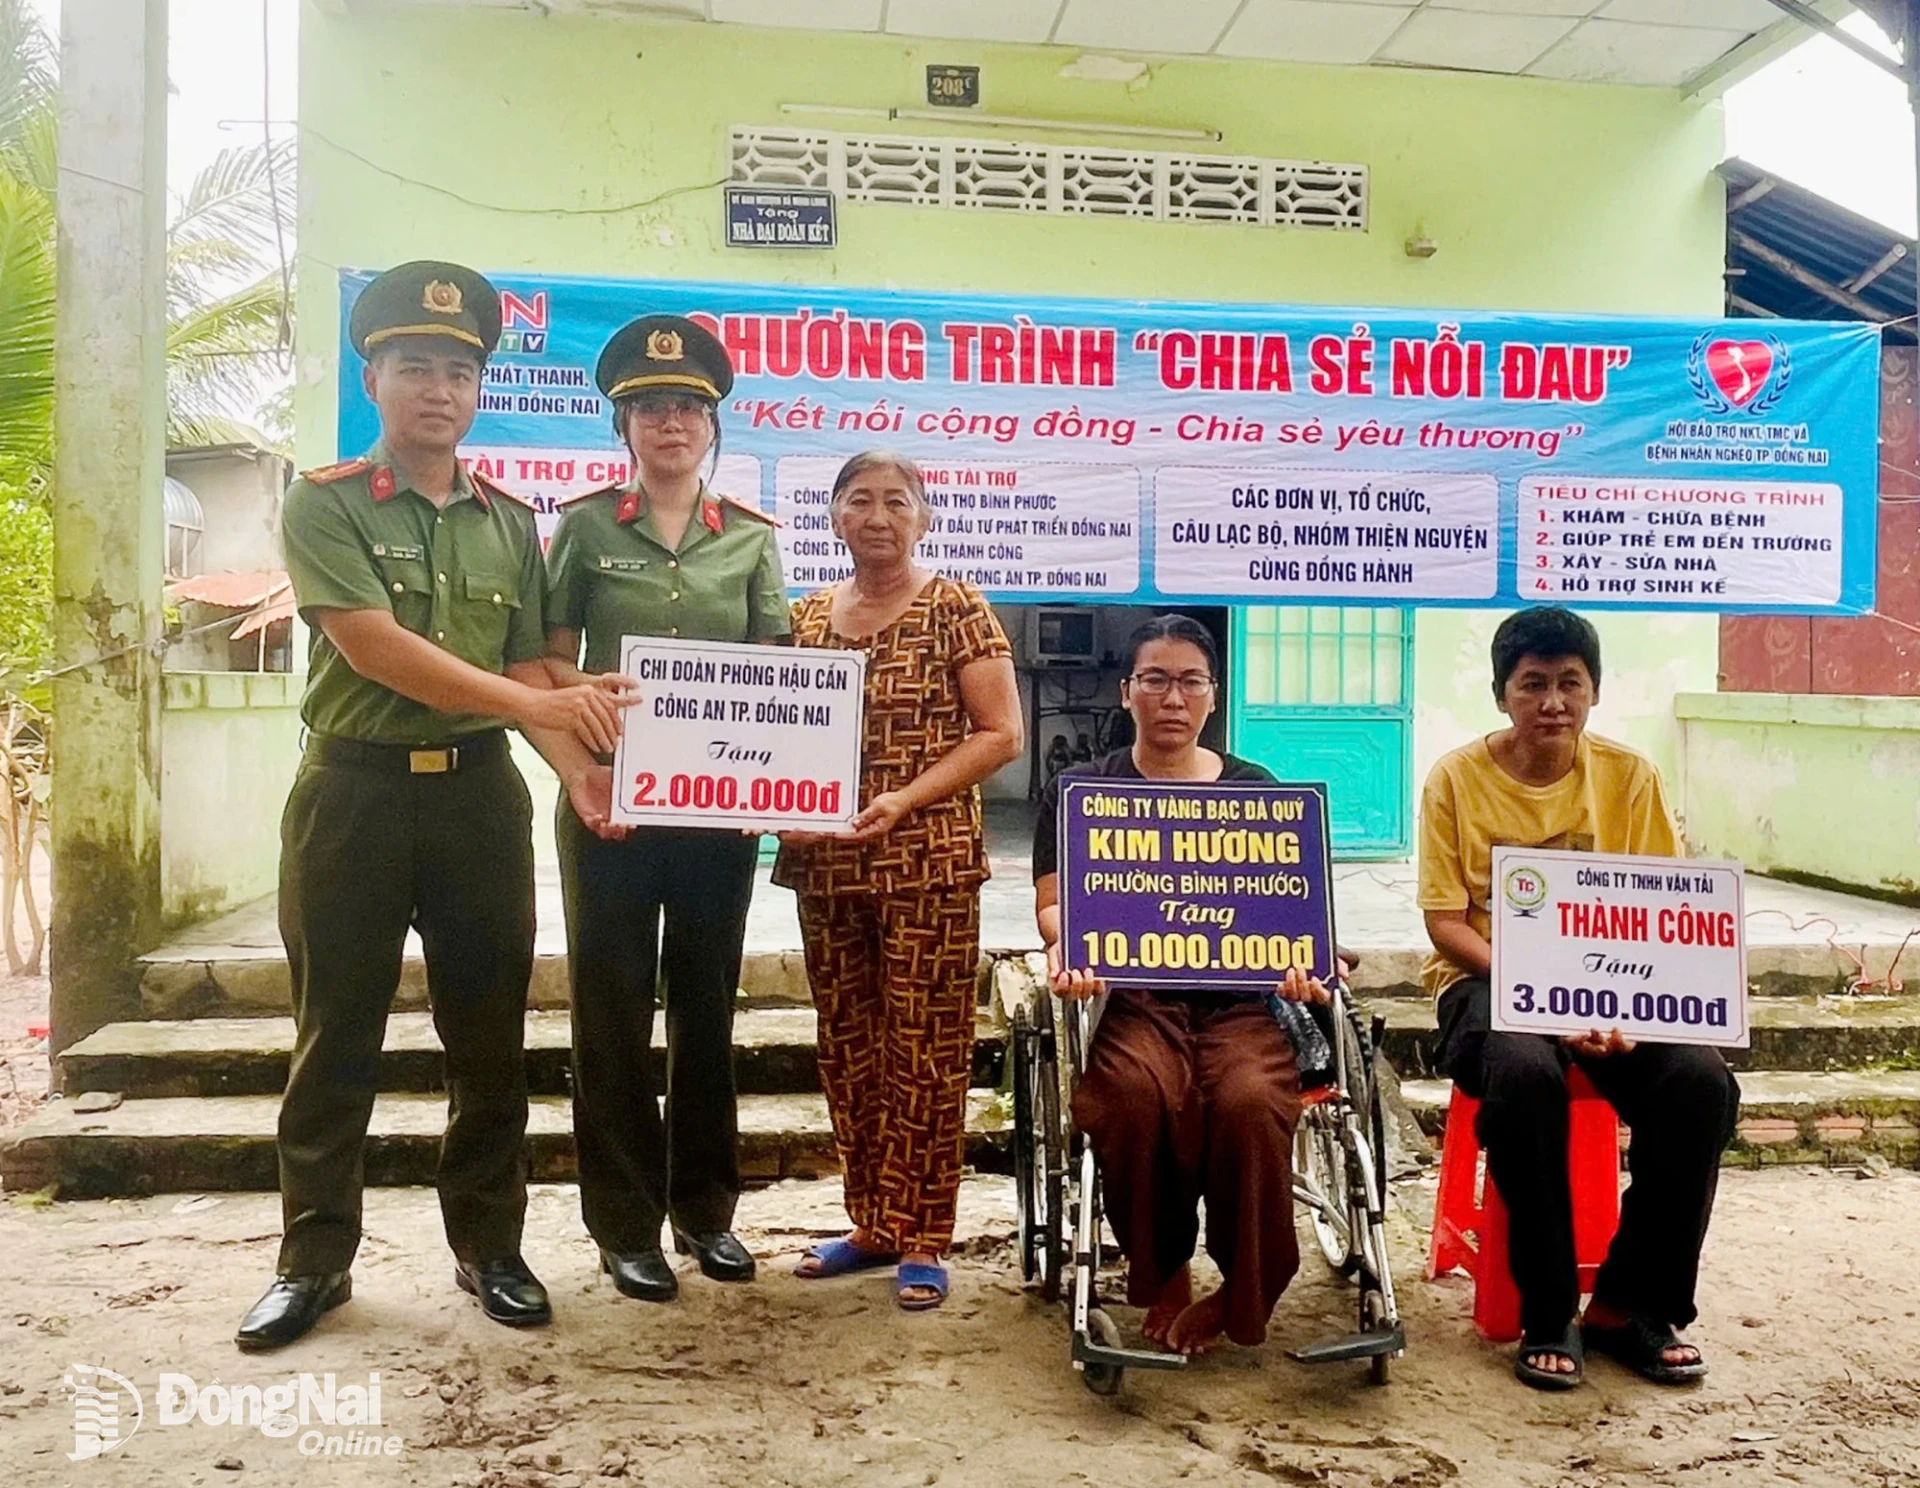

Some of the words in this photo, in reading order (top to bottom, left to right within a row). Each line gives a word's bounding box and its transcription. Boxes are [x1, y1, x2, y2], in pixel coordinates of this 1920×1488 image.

[686, 309, 924, 381] HƯƠNG
[945, 318, 1115, 386] TRÌNH
[1311, 326, 1373, 395] SẺ
[1393, 324, 1483, 398] NỖI
[571, 399, 600, 415] NAI
[838, 399, 906, 432] nối
[917, 406, 1019, 443] cộng
[1034, 405, 1136, 447] đồng
[1177, 414, 1264, 442] Chia
[1277, 417, 1323, 444] sẻ
[1334, 419, 1404, 452] yêu
[1668, 420, 1687, 440] HỘI
[1647, 442, 1677, 463] BỆNH
[1807, 451, 1828, 465] NAI
[516, 458, 577, 486] TRỢ
[956, 468, 980, 486] TÀI
[987, 470, 1018, 491] TRỢ
[793, 486, 830, 505] CÔNG
[952, 493, 976, 511] THỌ
[980, 493, 1010, 510] BÌNH
[1014, 493, 1057, 511] PHƯỚC
[1232, 483, 1270, 509] CÁC
[1275, 486, 1314, 510] ĐƠN
[1348, 482, 1372, 512] TỔ
[1376, 487, 1431, 515] CHỨC,
[1533, 484, 1588, 501] TIÊU
[1595, 485, 1637, 502] CHÍ
[1644, 488, 1747, 504] CHƯƠNG
[1755, 489, 1825, 506] TRÌNH
[793, 513, 830, 531] CÔNG
[977, 519, 994, 535] TƯ
[996, 517, 1028, 536] PHÁT
[1110, 522, 1132, 538] NAI
[1537, 509, 1556, 523] 1.
[1562, 507, 1626, 525] KHÁM
[1647, 508, 1704, 526] CHỮA
[1711, 510, 1766, 530] BỆNH
[793, 538, 830, 557] CÔNG
[834, 541, 847, 556] TY
[919, 541, 939, 559] TẢI
[943, 542, 985, 560] THÀNH
[988, 542, 1024, 560] CÔNG
[1172, 517, 1210, 544] CÂU
[1216, 523, 1252, 549] LẠC
[1257, 520, 1288, 550] BỘ,
[1293, 520, 1350, 547] NHÓM
[1355, 522, 1408, 552] THIỆN
[1414, 524, 1488, 554] NGUYỆN
[1536, 532, 1556, 546] 2.
[1563, 530, 1612, 547] GIÚP
[1619, 529, 1657, 549] TRẺ
[1664, 534, 1696, 549] EM
[1702, 531, 1745, 550] ĐẾN
[1751, 534, 1833, 553] TRƯỜNG
[1249, 556, 1300, 582] CÙNG
[1363, 558, 1413, 583] HÀNH
[1562, 552, 1603, 570] XÂY
[1625, 552, 1667, 571] SỬA
[1674, 556, 1717, 572] NHÀ
[793, 566, 816, 582] CHI
[1005, 571, 1023, 586] AN
[1084, 572, 1107, 587] NAI
[1535, 577, 1555, 592] 4.
[1562, 573, 1590, 593] HỖ
[1597, 578, 1637, 596] TRỢ
[1643, 578, 1693, 594] SINH
[1701, 576, 1729, 594] KẾ
[640, 658, 668, 681] CHI
[672, 656, 716, 684] ĐOÀN
[720, 659, 774, 687] PHÒNG
[779, 663, 811, 694] HẬU
[815, 661, 849, 691] CẦN
[654, 692, 699, 720] CÔNG
[703, 701, 726, 721] AN
[730, 701, 751, 723] TP.
[755, 695, 800, 726] ĐỒNG
[803, 705, 832, 727] NAI
[706, 740, 774, 766] Tặng
[632, 771, 843, 815] 2.000.000đ
[1082, 791, 1130, 818] CÔNG
[1133, 798, 1153, 818] TY
[1156, 794, 1203, 820] VÀNG
[1206, 799, 1241, 826] BẠC
[1244, 795, 1269, 821] ĐÁ
[1272, 795, 1306, 824] QUÝ
[1088, 827, 1161, 863] KIM
[1172, 827, 1301, 865] HƯƠNG
[1083, 867, 1176, 896] (PHƯỜNG
[1180, 869, 1228, 895] BÌNH
[1233, 869, 1311, 900] PHƯỚC)
[1576, 866, 1610, 889] CÔNG
[1613, 872, 1628, 887] TY
[1631, 873, 1663, 892] TNHH
[1666, 873, 1692, 897] VẬN
[1694, 871, 1714, 894] TẢI
[1159, 899, 1236, 931] Tặng
[1557, 896, 1649, 943] THÀNH
[1657, 901, 1736, 948] CÔNG
[1081, 930, 1316, 972] 10.000.000đ
[1582, 952, 1655, 981] Tặng
[1513, 982, 1729, 1028] 3.000.000đ
